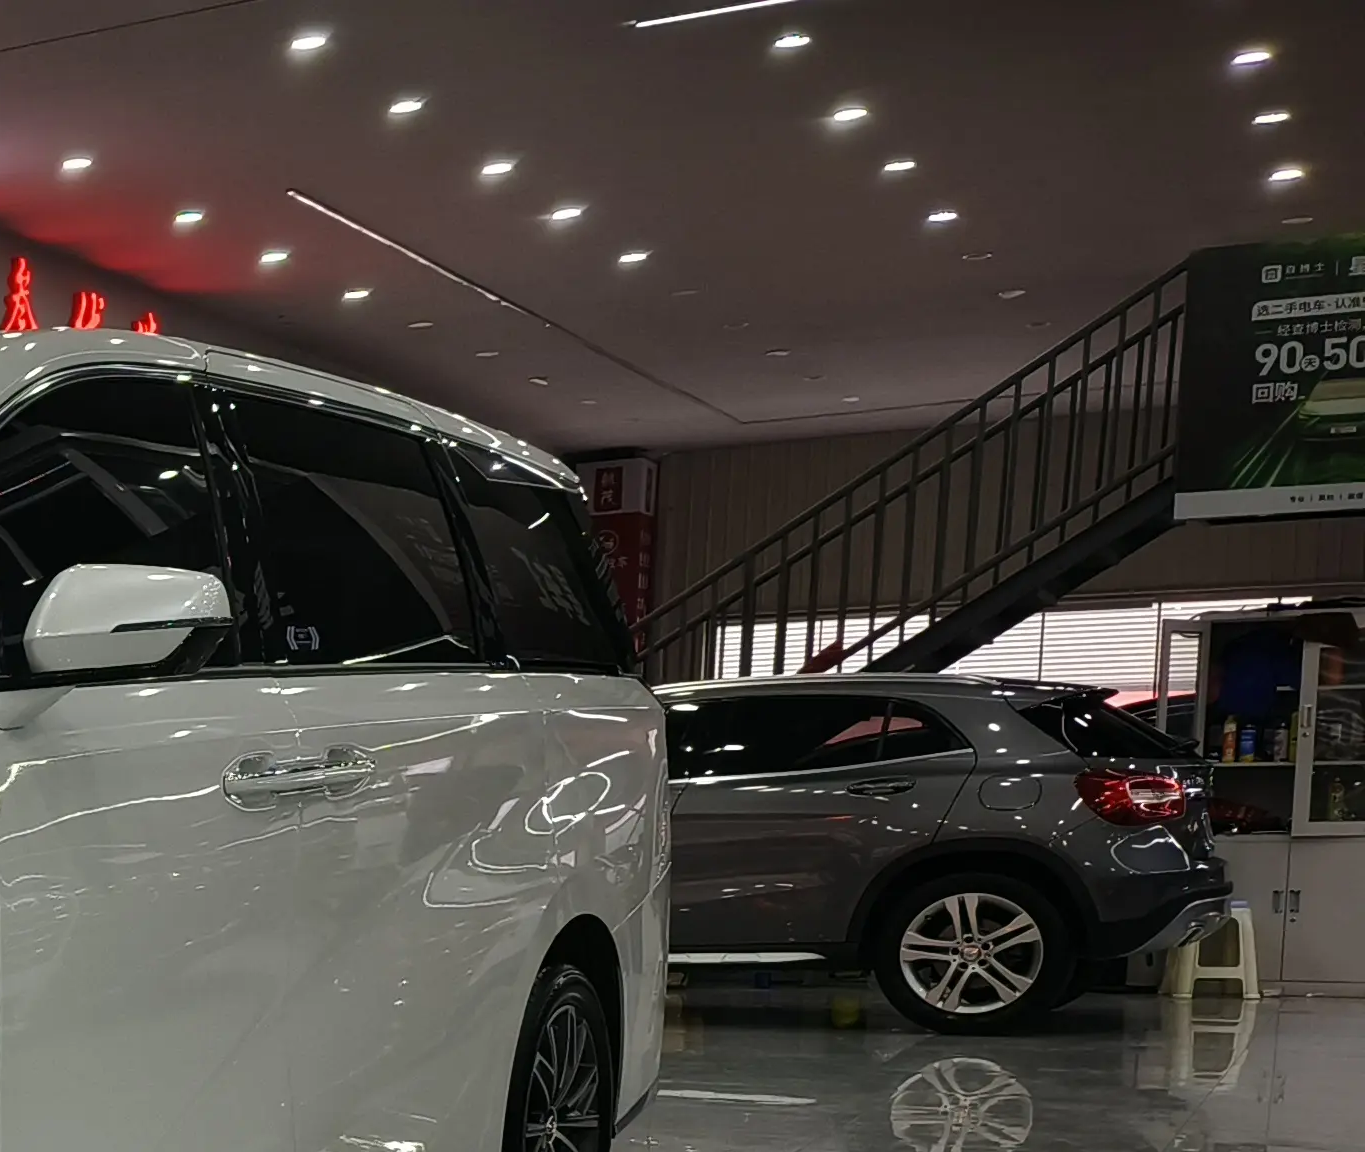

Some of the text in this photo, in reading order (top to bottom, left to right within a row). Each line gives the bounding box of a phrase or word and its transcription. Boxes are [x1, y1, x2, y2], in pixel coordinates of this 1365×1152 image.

[1257, 296, 1365, 317] 选二手电车·认准
